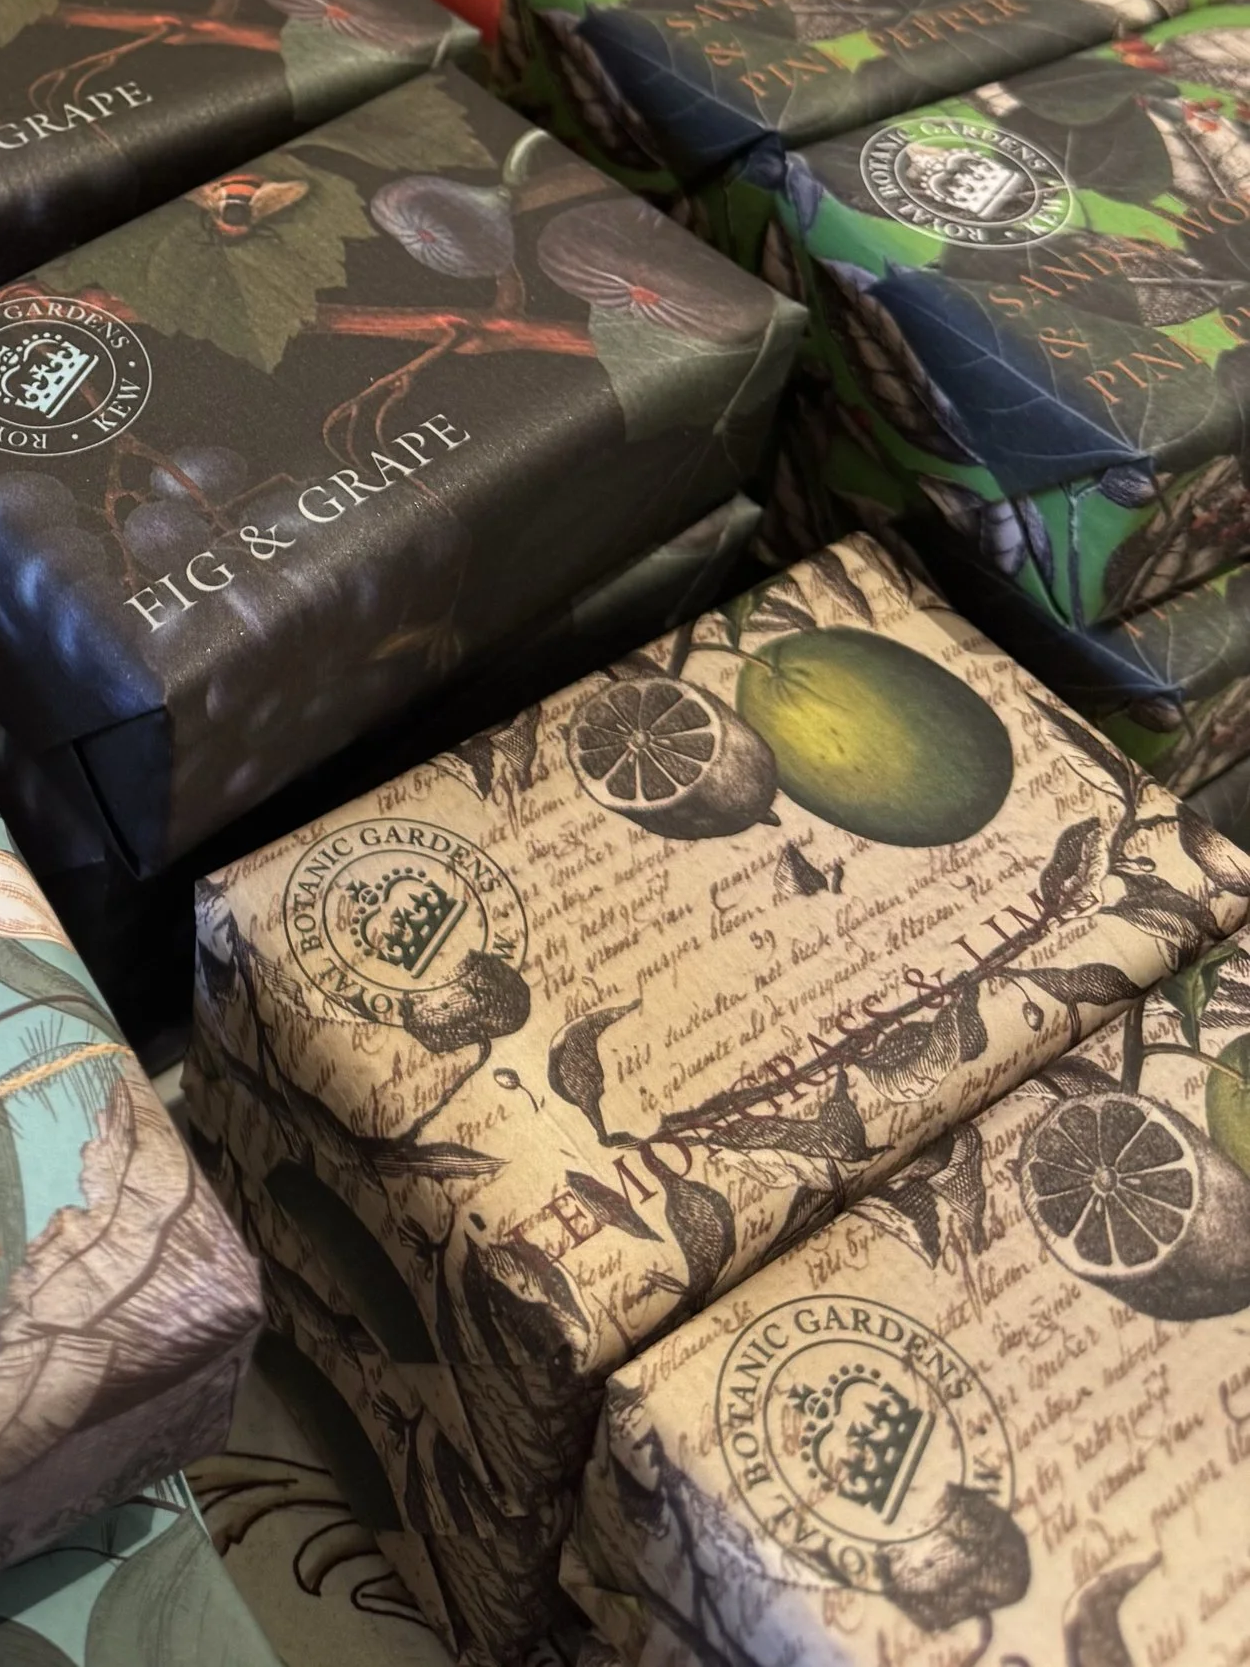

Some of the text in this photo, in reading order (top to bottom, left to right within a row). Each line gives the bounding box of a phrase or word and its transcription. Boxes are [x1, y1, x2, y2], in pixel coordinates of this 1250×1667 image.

[704, 40, 747, 67] &
[868, 122, 1049, 243] ROYAL BOTANIC GARDENS
[1020, 191, 1065, 236] KEW
[2, 301, 131, 350] GARDENS
[1038, 326, 1090, 358] &
[91, 377, 142, 432] KEW
[124, 413, 472, 633] FIG & GRAPE
[293, 836, 354, 956] BOTANIC
[359, 824, 503, 894] GARDENS
[903, 967, 959, 1010] &
[727, 1322, 790, 1489] BOTANIC
[793, 1304, 973, 1400] GARDENS
